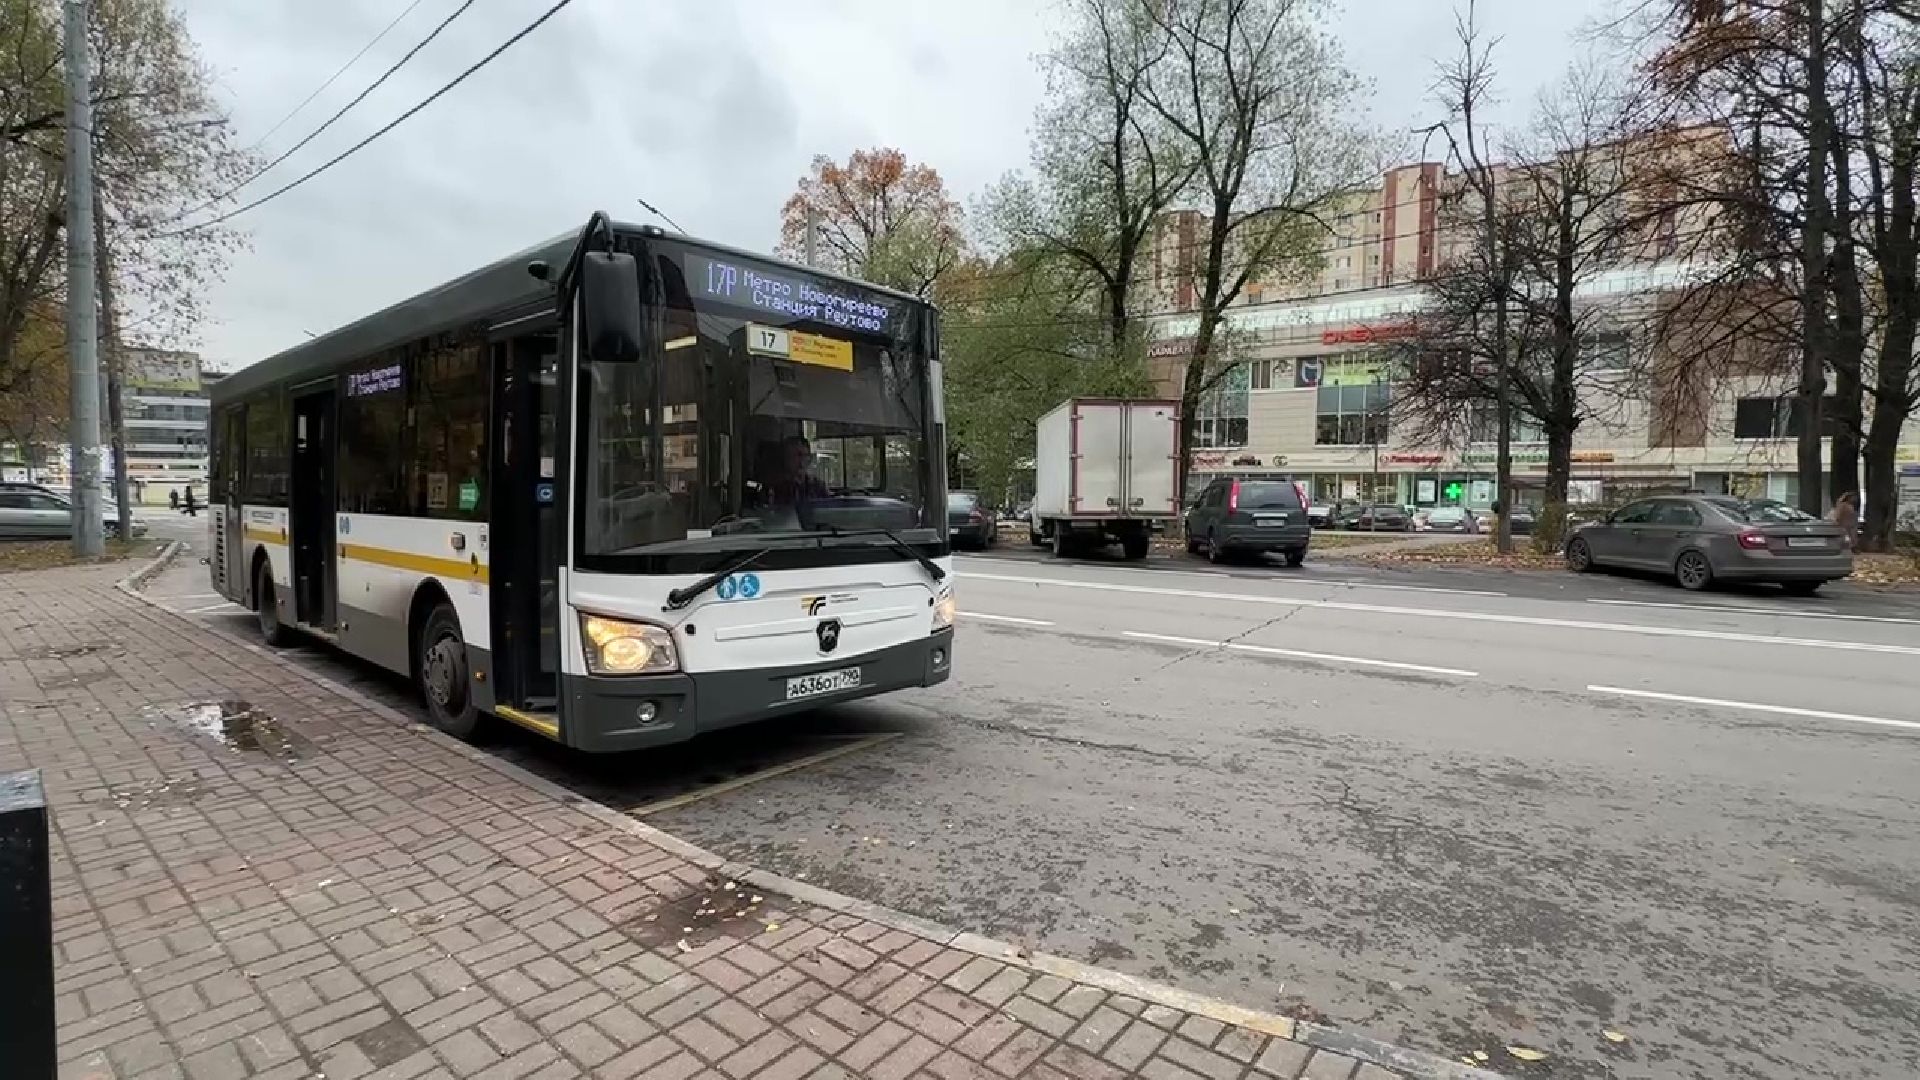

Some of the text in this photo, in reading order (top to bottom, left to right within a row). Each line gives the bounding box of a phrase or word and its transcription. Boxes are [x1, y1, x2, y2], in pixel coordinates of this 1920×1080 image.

[706, 261, 737, 296] 17Р
[743, 269, 889, 319] Метро Новогиреево
[752, 289, 882, 331] Станция Реутово
[761, 330, 776, 349] 17
